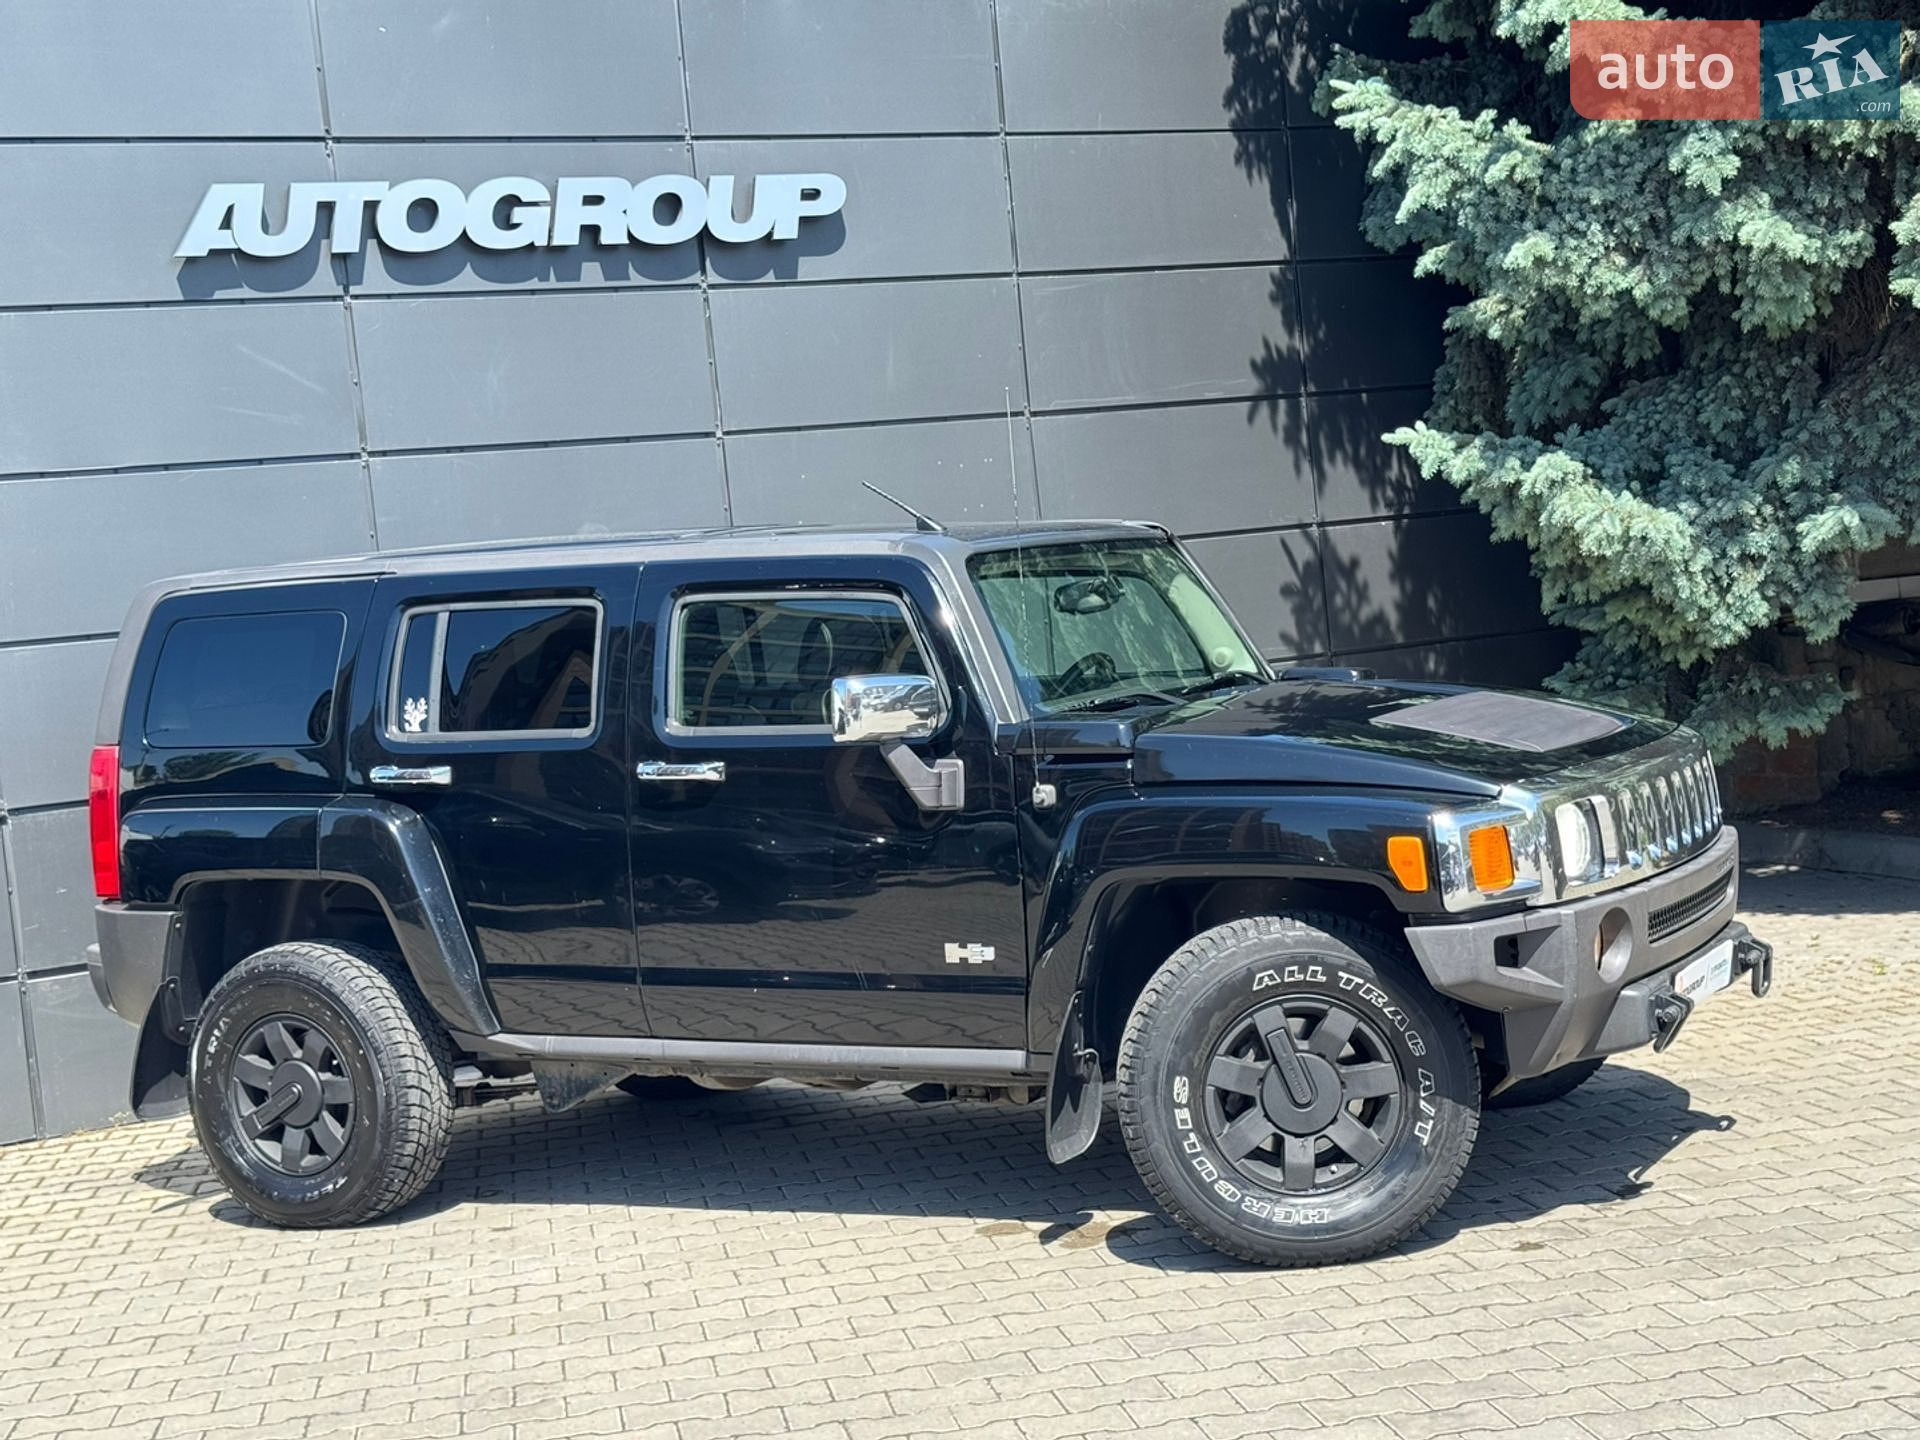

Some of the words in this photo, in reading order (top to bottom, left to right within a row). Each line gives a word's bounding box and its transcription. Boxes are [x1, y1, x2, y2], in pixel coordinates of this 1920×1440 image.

[173, 172, 847, 258] AUTOGROUP
[1252, 965, 1327, 992] ALL
[1337, 970, 1427, 1058] TRAC
[1413, 1067, 1436, 1148] A/T
[1173, 1075, 1331, 1225] HERCULES
